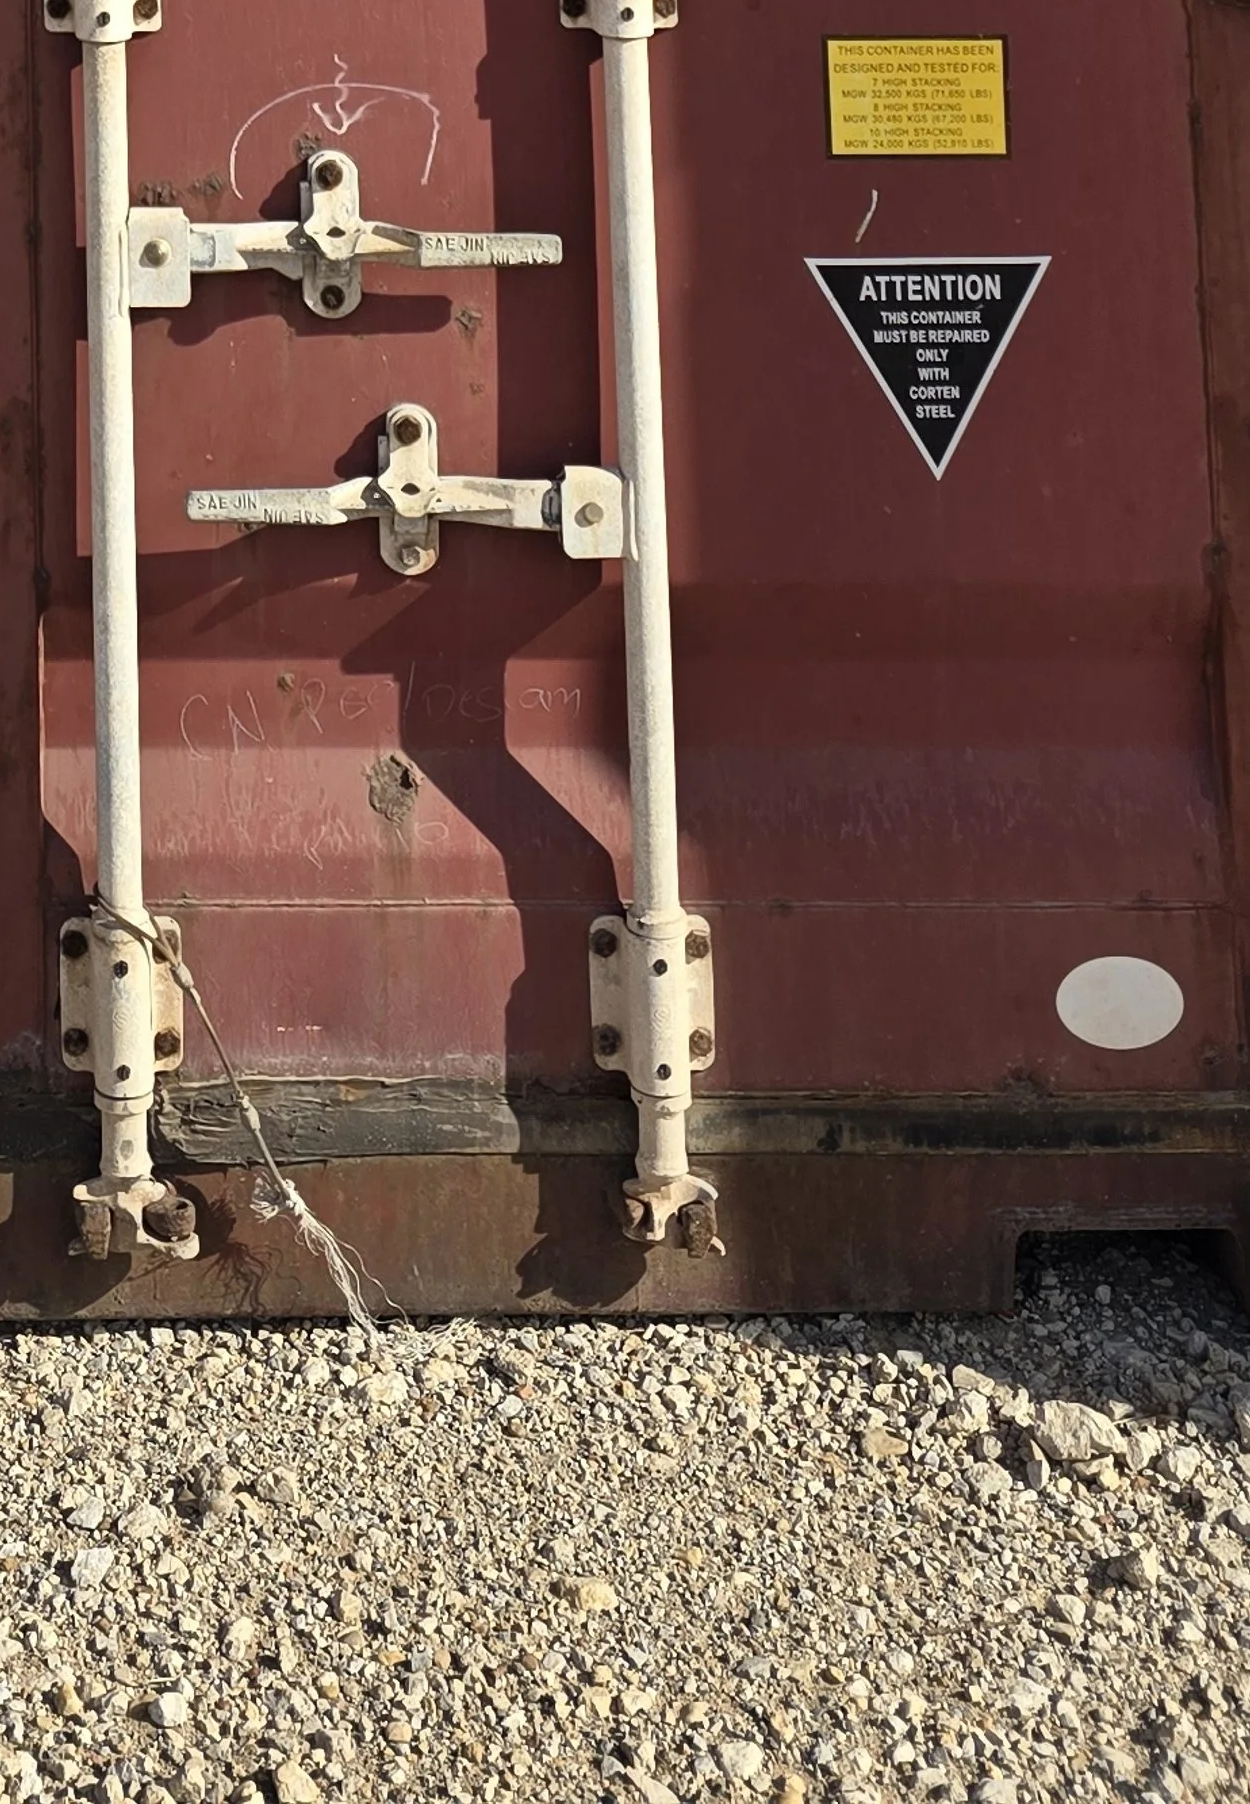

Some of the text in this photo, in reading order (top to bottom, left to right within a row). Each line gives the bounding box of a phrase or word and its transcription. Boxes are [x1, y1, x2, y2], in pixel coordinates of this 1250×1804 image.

[838, 45, 994, 56] THIS CONTAINER HAS BEEN
[833, 63, 895, 74] DESIGNED
[896, 63, 920, 74] AND
[924, 63, 969, 73] TESTED
[882, 78, 907, 87] HIGH
[911, 78, 961, 87] STACKING
[906, 89, 927, 98] KGS
[883, 102, 908, 111] HIGH
[912, 102, 962, 111] STACKING
[907, 114, 928, 123] KGS
[884, 128, 909, 136] HIGH
[913, 128, 963, 136] STACKING
[908, 139, 929, 148] KGS
[425, 237, 485, 252] SAE JIN
[859, 274, 1001, 301] ATTENTION
[880, 311, 982, 324] THIS CONTAINER
[873, 329, 990, 343] MUST BE REPAIRED
[916, 348, 949, 362] ONLY
[918, 367, 950, 381] WITH
[909, 386, 961, 399] CORTEN
[916, 405, 956, 419] STEEL
[197, 495, 227, 510] SAE
